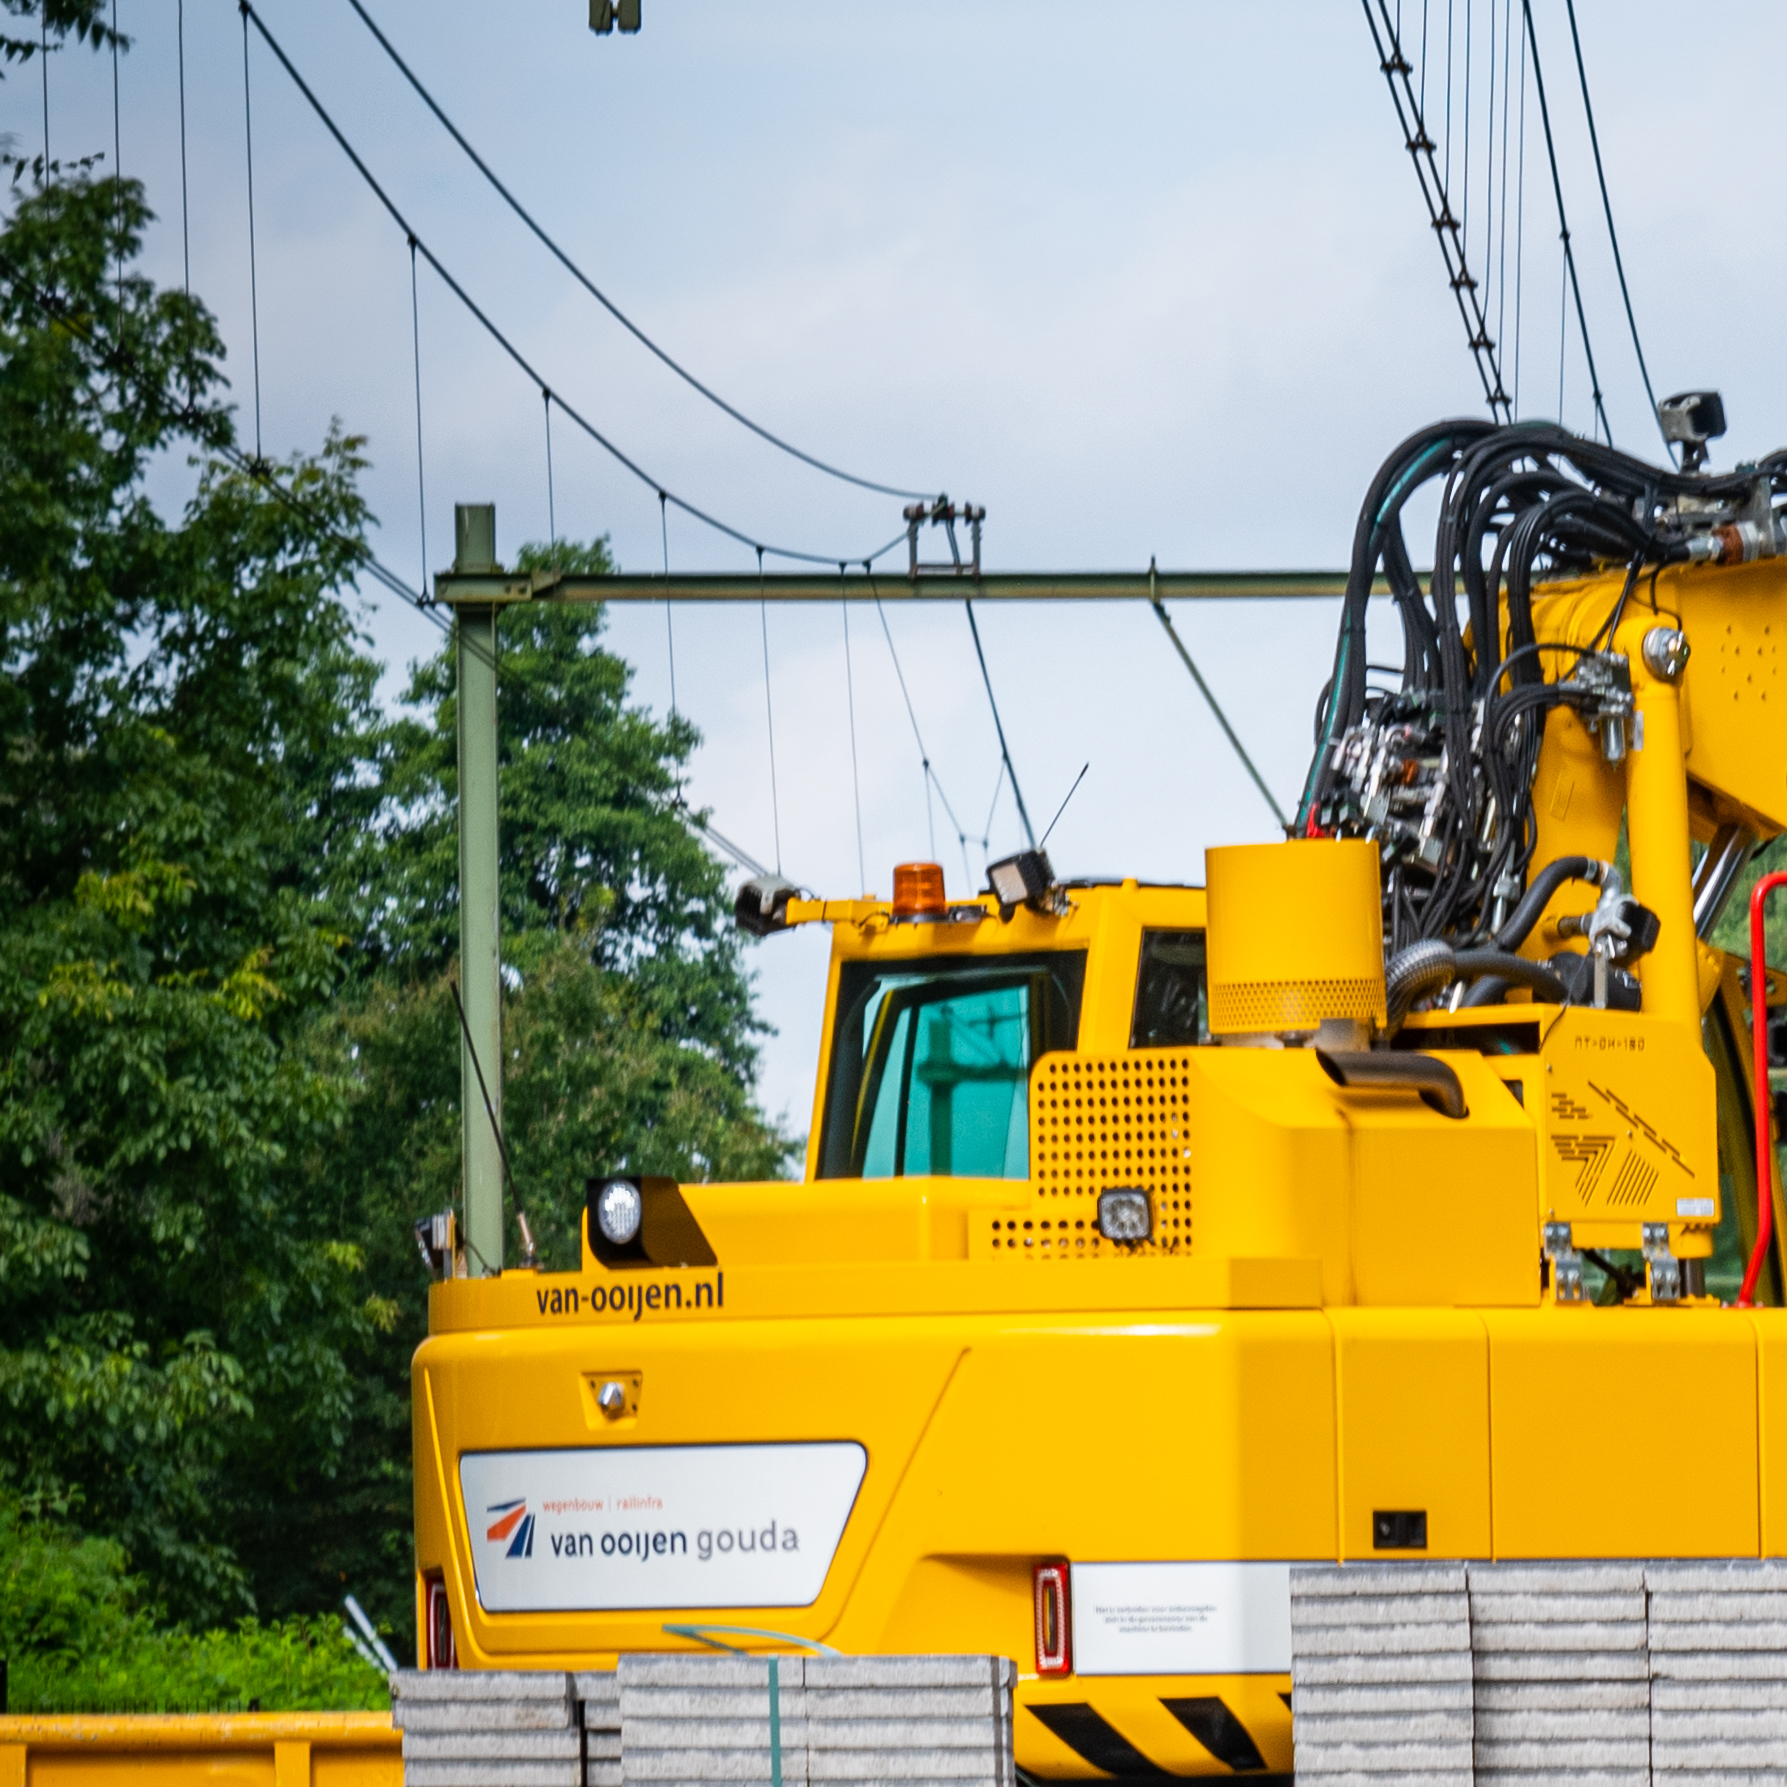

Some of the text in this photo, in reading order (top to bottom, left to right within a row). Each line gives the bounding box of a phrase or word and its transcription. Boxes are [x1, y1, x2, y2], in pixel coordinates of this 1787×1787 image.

[536, 1271, 724, 1322] van-ooijen.nl
[550, 1519, 799, 1563] van ooijen gouda
